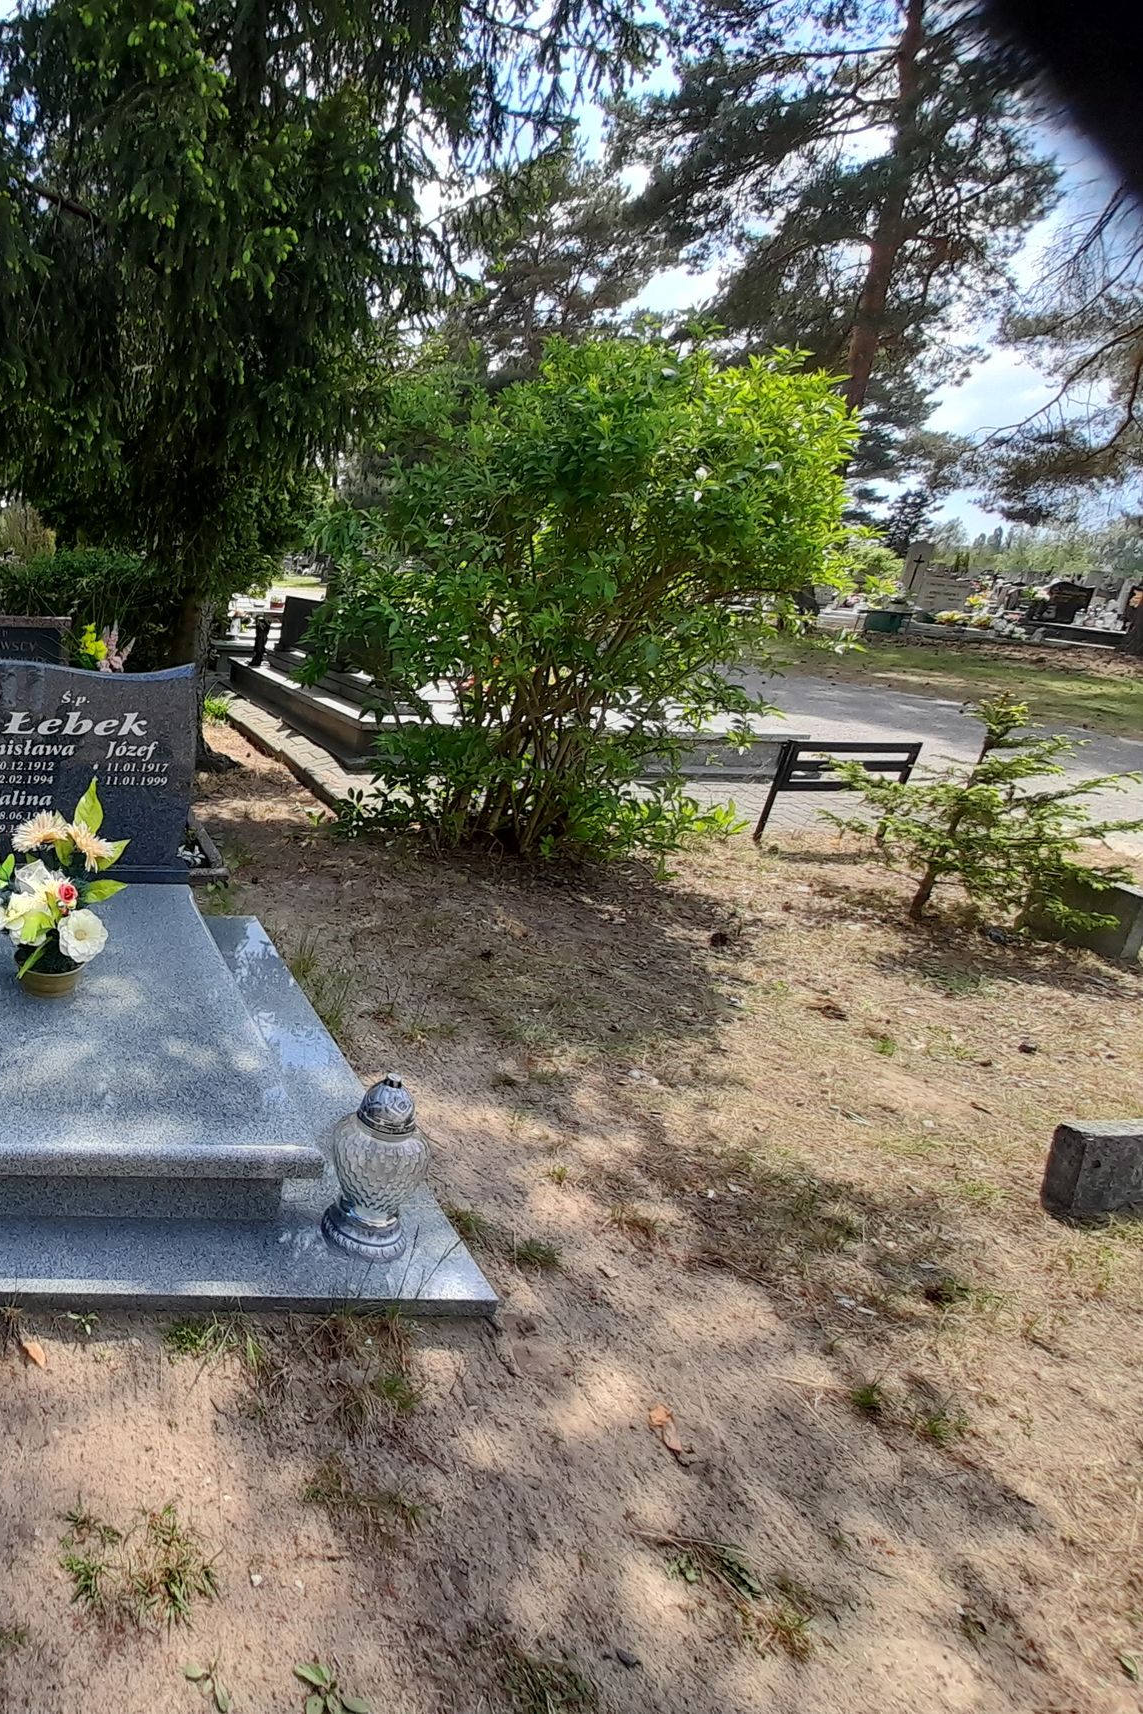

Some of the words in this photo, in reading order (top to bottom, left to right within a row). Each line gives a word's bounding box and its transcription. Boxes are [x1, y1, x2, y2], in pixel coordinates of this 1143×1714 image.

[2, 711, 148, 737] Łebek
[106, 741, 158, 761] Józef
[106, 763, 169, 773] 11.01.1917
[106, 776, 168, 786] 11.01.1999
